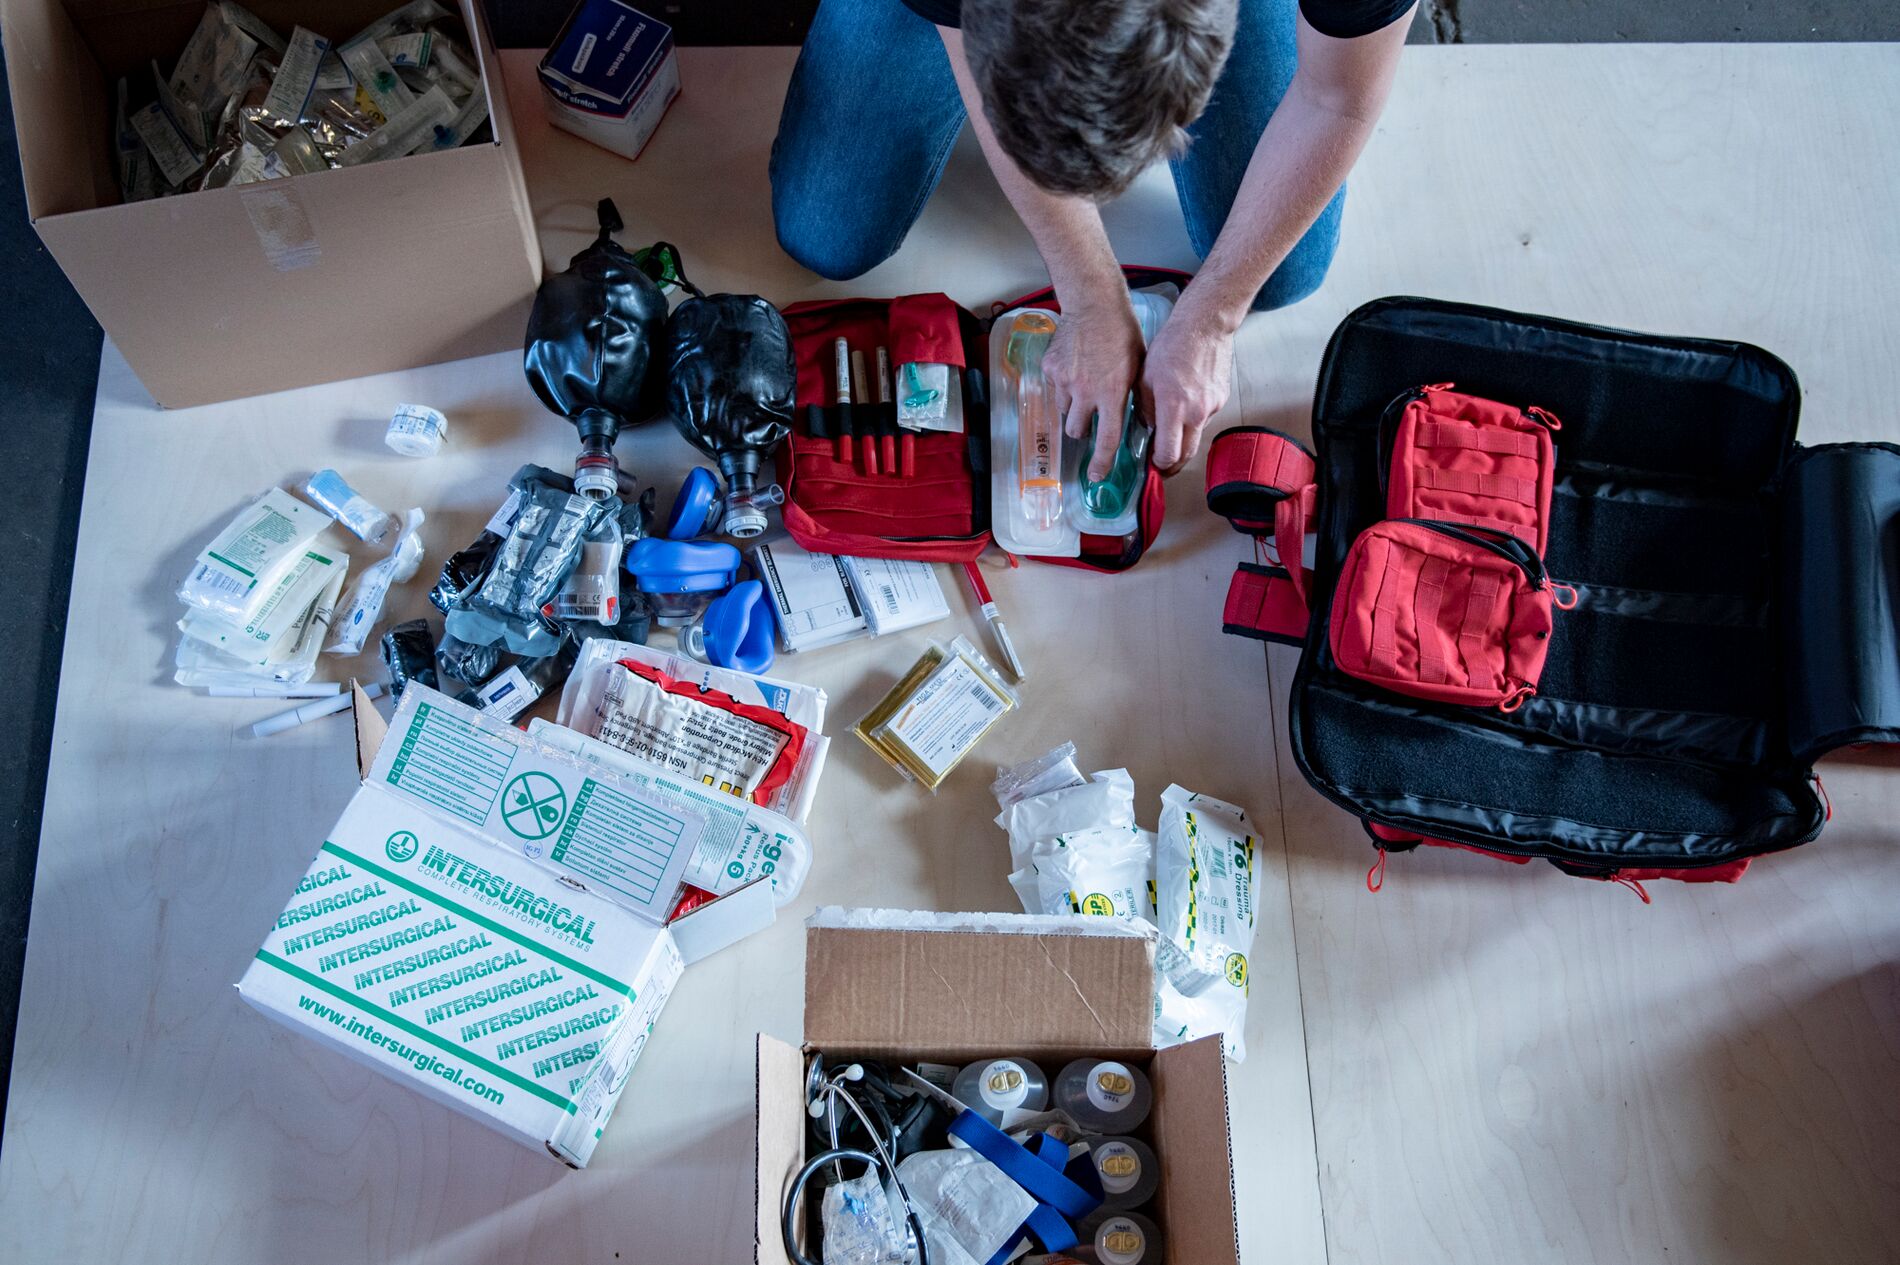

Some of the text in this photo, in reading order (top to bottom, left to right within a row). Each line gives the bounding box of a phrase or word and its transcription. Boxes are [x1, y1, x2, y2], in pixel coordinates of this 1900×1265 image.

[605, 50, 626, 78] stretch
[761, 545, 789, 613] THERMAL EMERGENCY BLANKET
[614, 710, 627, 719] Pad
[680, 723, 723, 747] Corporation
[667, 742, 707, 764] Compression
[668, 755, 687, 769] NSN
[691, 742, 718, 758] Bandage
[706, 759, 733, 774] Pressure
[717, 753, 738, 766] Sterile
[723, 742, 752, 759] Medical
[743, 832, 768, 883] Resus Pack
[1234, 840, 1246, 869] T6
[417, 864, 591, 953] COMPLETE RESPIRATORY SYSTEMS
[420, 842, 602, 947] INTERSURGICAL
[1234, 872, 1243, 919] Dressing
[281, 897, 422, 955] INTERSURGICAL
[317, 914, 457, 973] INTERSURGICAL
[352, 931, 493, 990] INTERSURGICAL
[387, 948, 528, 1007] INTERSURGICAL
[422, 965, 563, 1025] INTERSURGICAL
[458, 982, 599, 1042] INTERSURGICAL
[296, 987, 506, 1111] www.intersurgical.com
